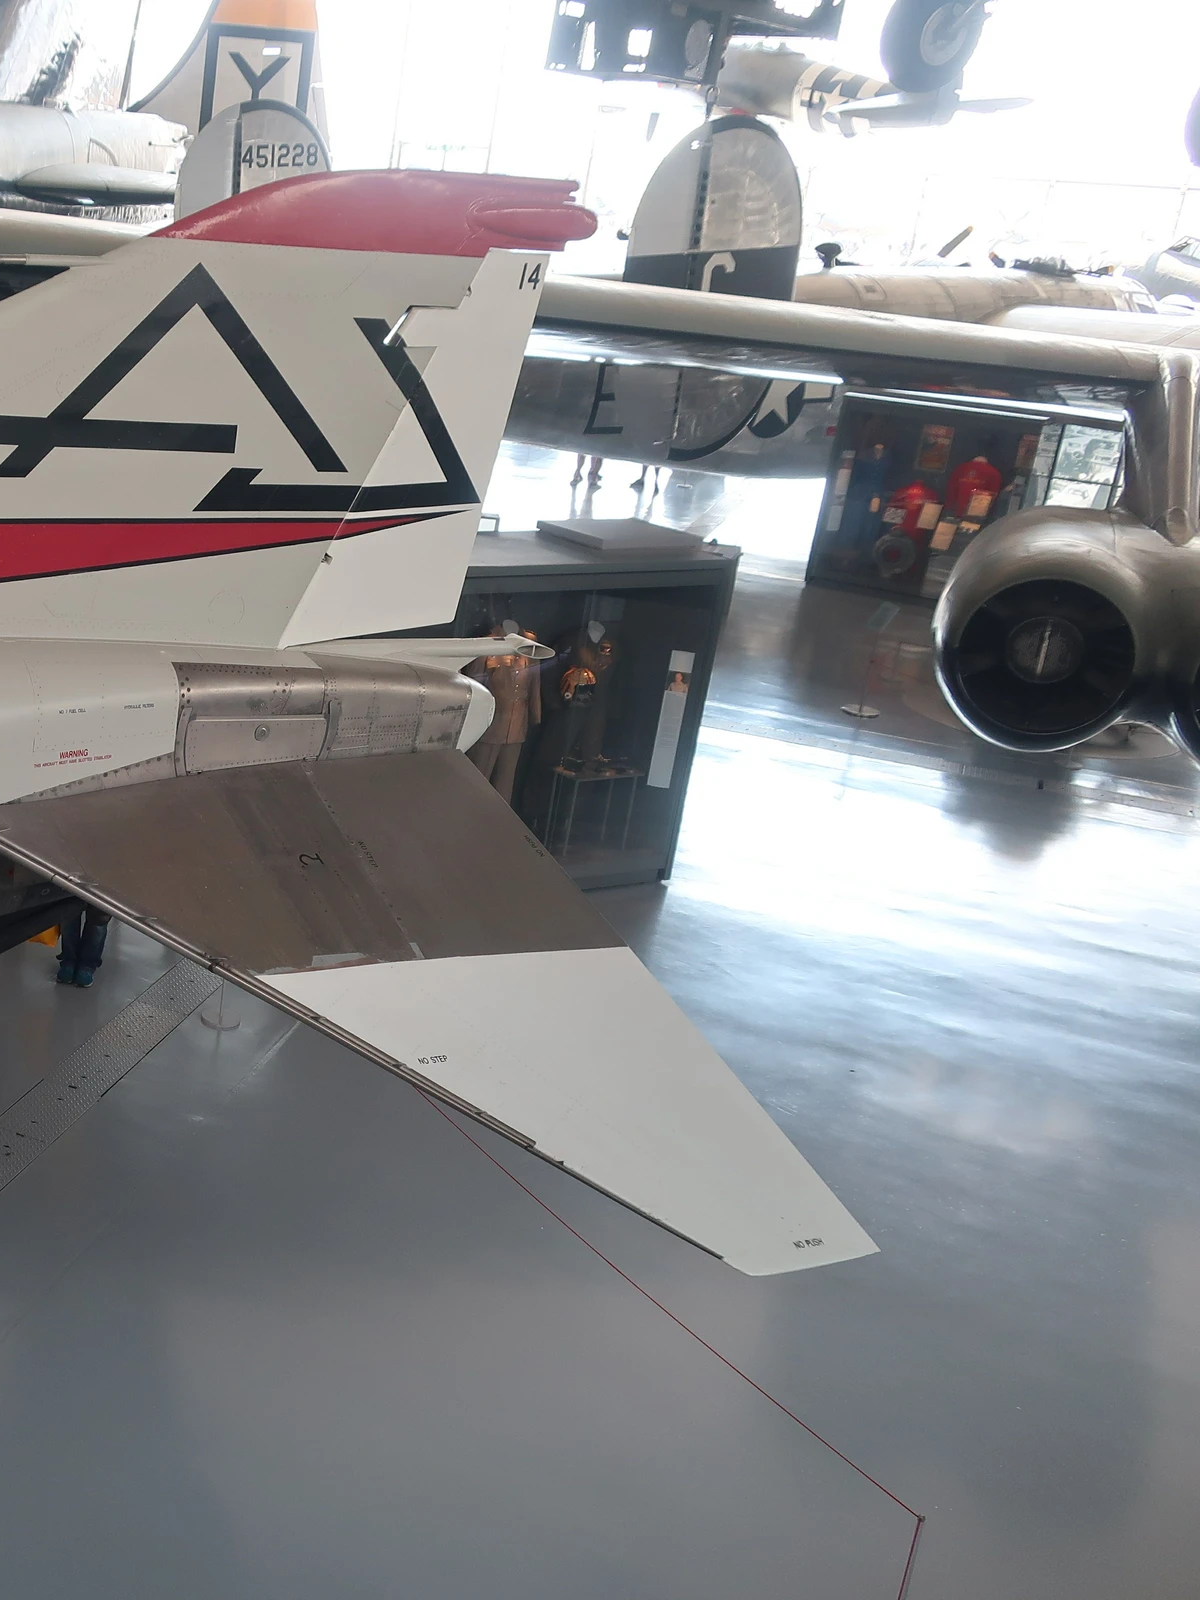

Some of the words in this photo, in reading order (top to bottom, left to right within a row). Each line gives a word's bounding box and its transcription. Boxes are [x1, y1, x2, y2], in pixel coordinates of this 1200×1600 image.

[228, 51, 291, 100] Y
[241, 142, 318, 168] 451228
[519, 262, 541, 290] 14
[59, 749, 88, 759] WARNING
[364, 851, 379, 868] STEP
[430, 1055, 447, 1063] STEP
[792, 1240, 805, 1249] NO
